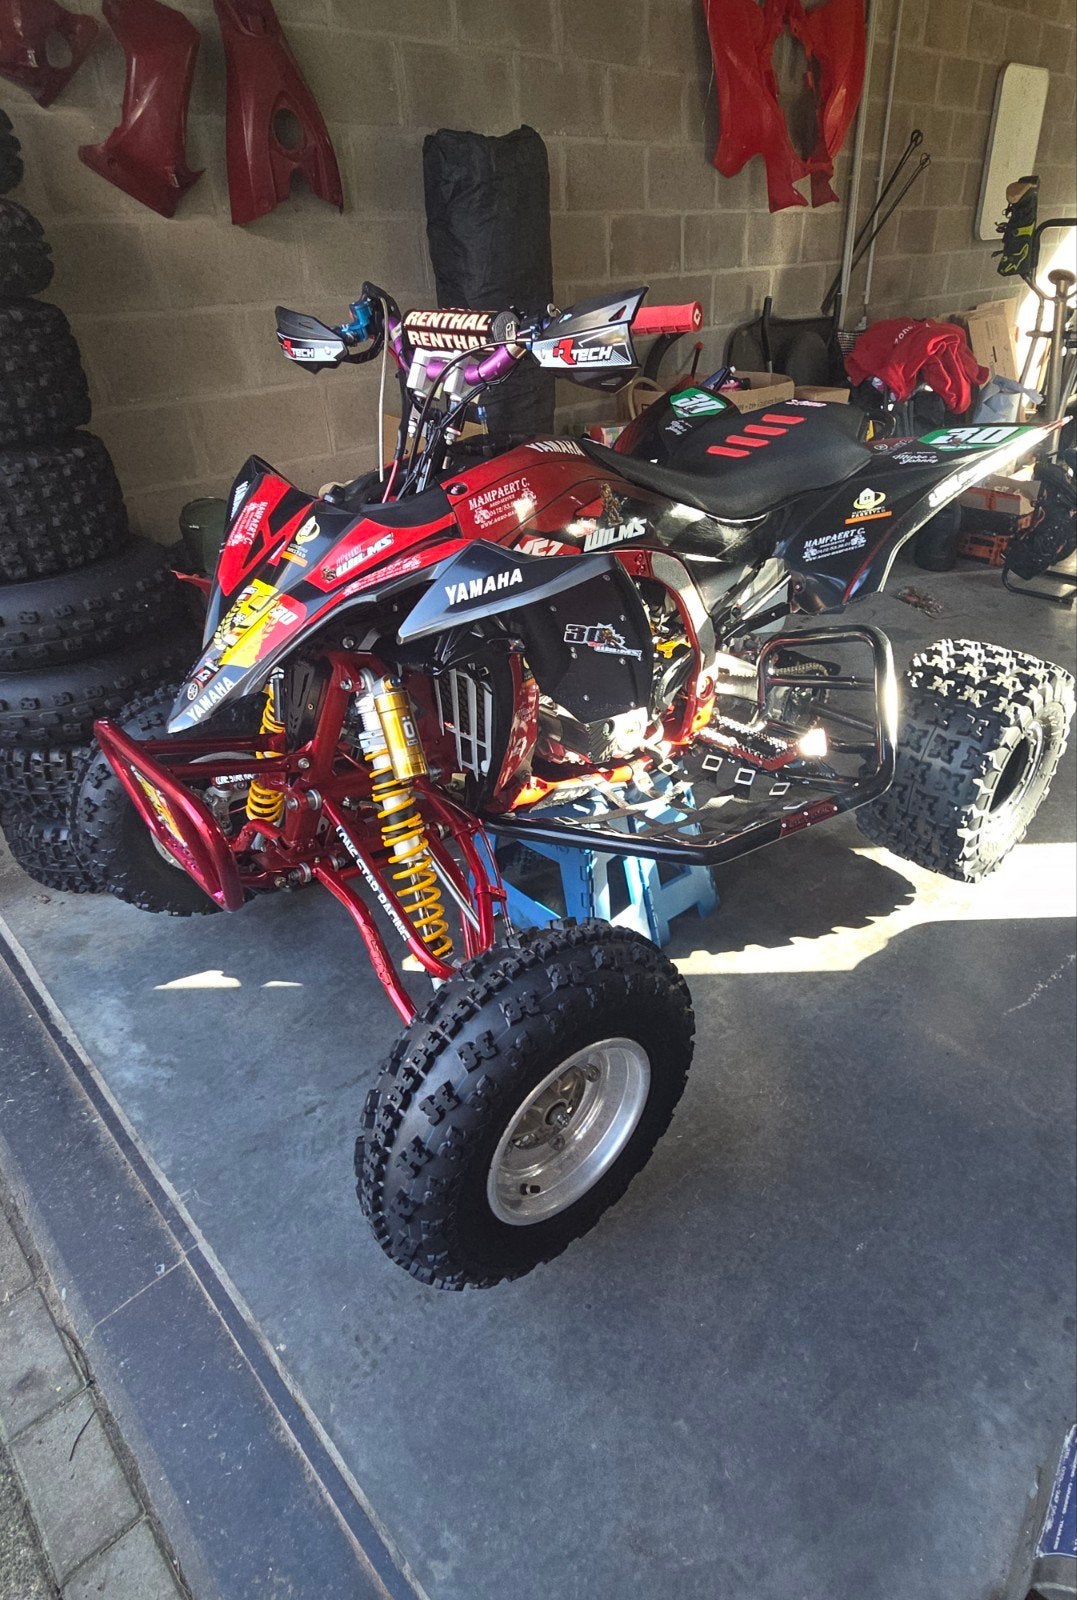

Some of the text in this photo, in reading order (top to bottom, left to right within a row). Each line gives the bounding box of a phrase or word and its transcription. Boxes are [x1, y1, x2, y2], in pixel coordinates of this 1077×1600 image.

[404, 311, 490, 331] RENTHAL
[929, 426, 1019, 444] 30
[525, 440, 586, 457] YAMAHA
[468, 480, 520, 510] MAMPAERT
[583, 518, 647, 552] WILMS
[803, 529, 857, 549] MAMPAERT
[445, 568, 523, 606] YAMAHA
[186, 676, 236, 721] YAMAHA
